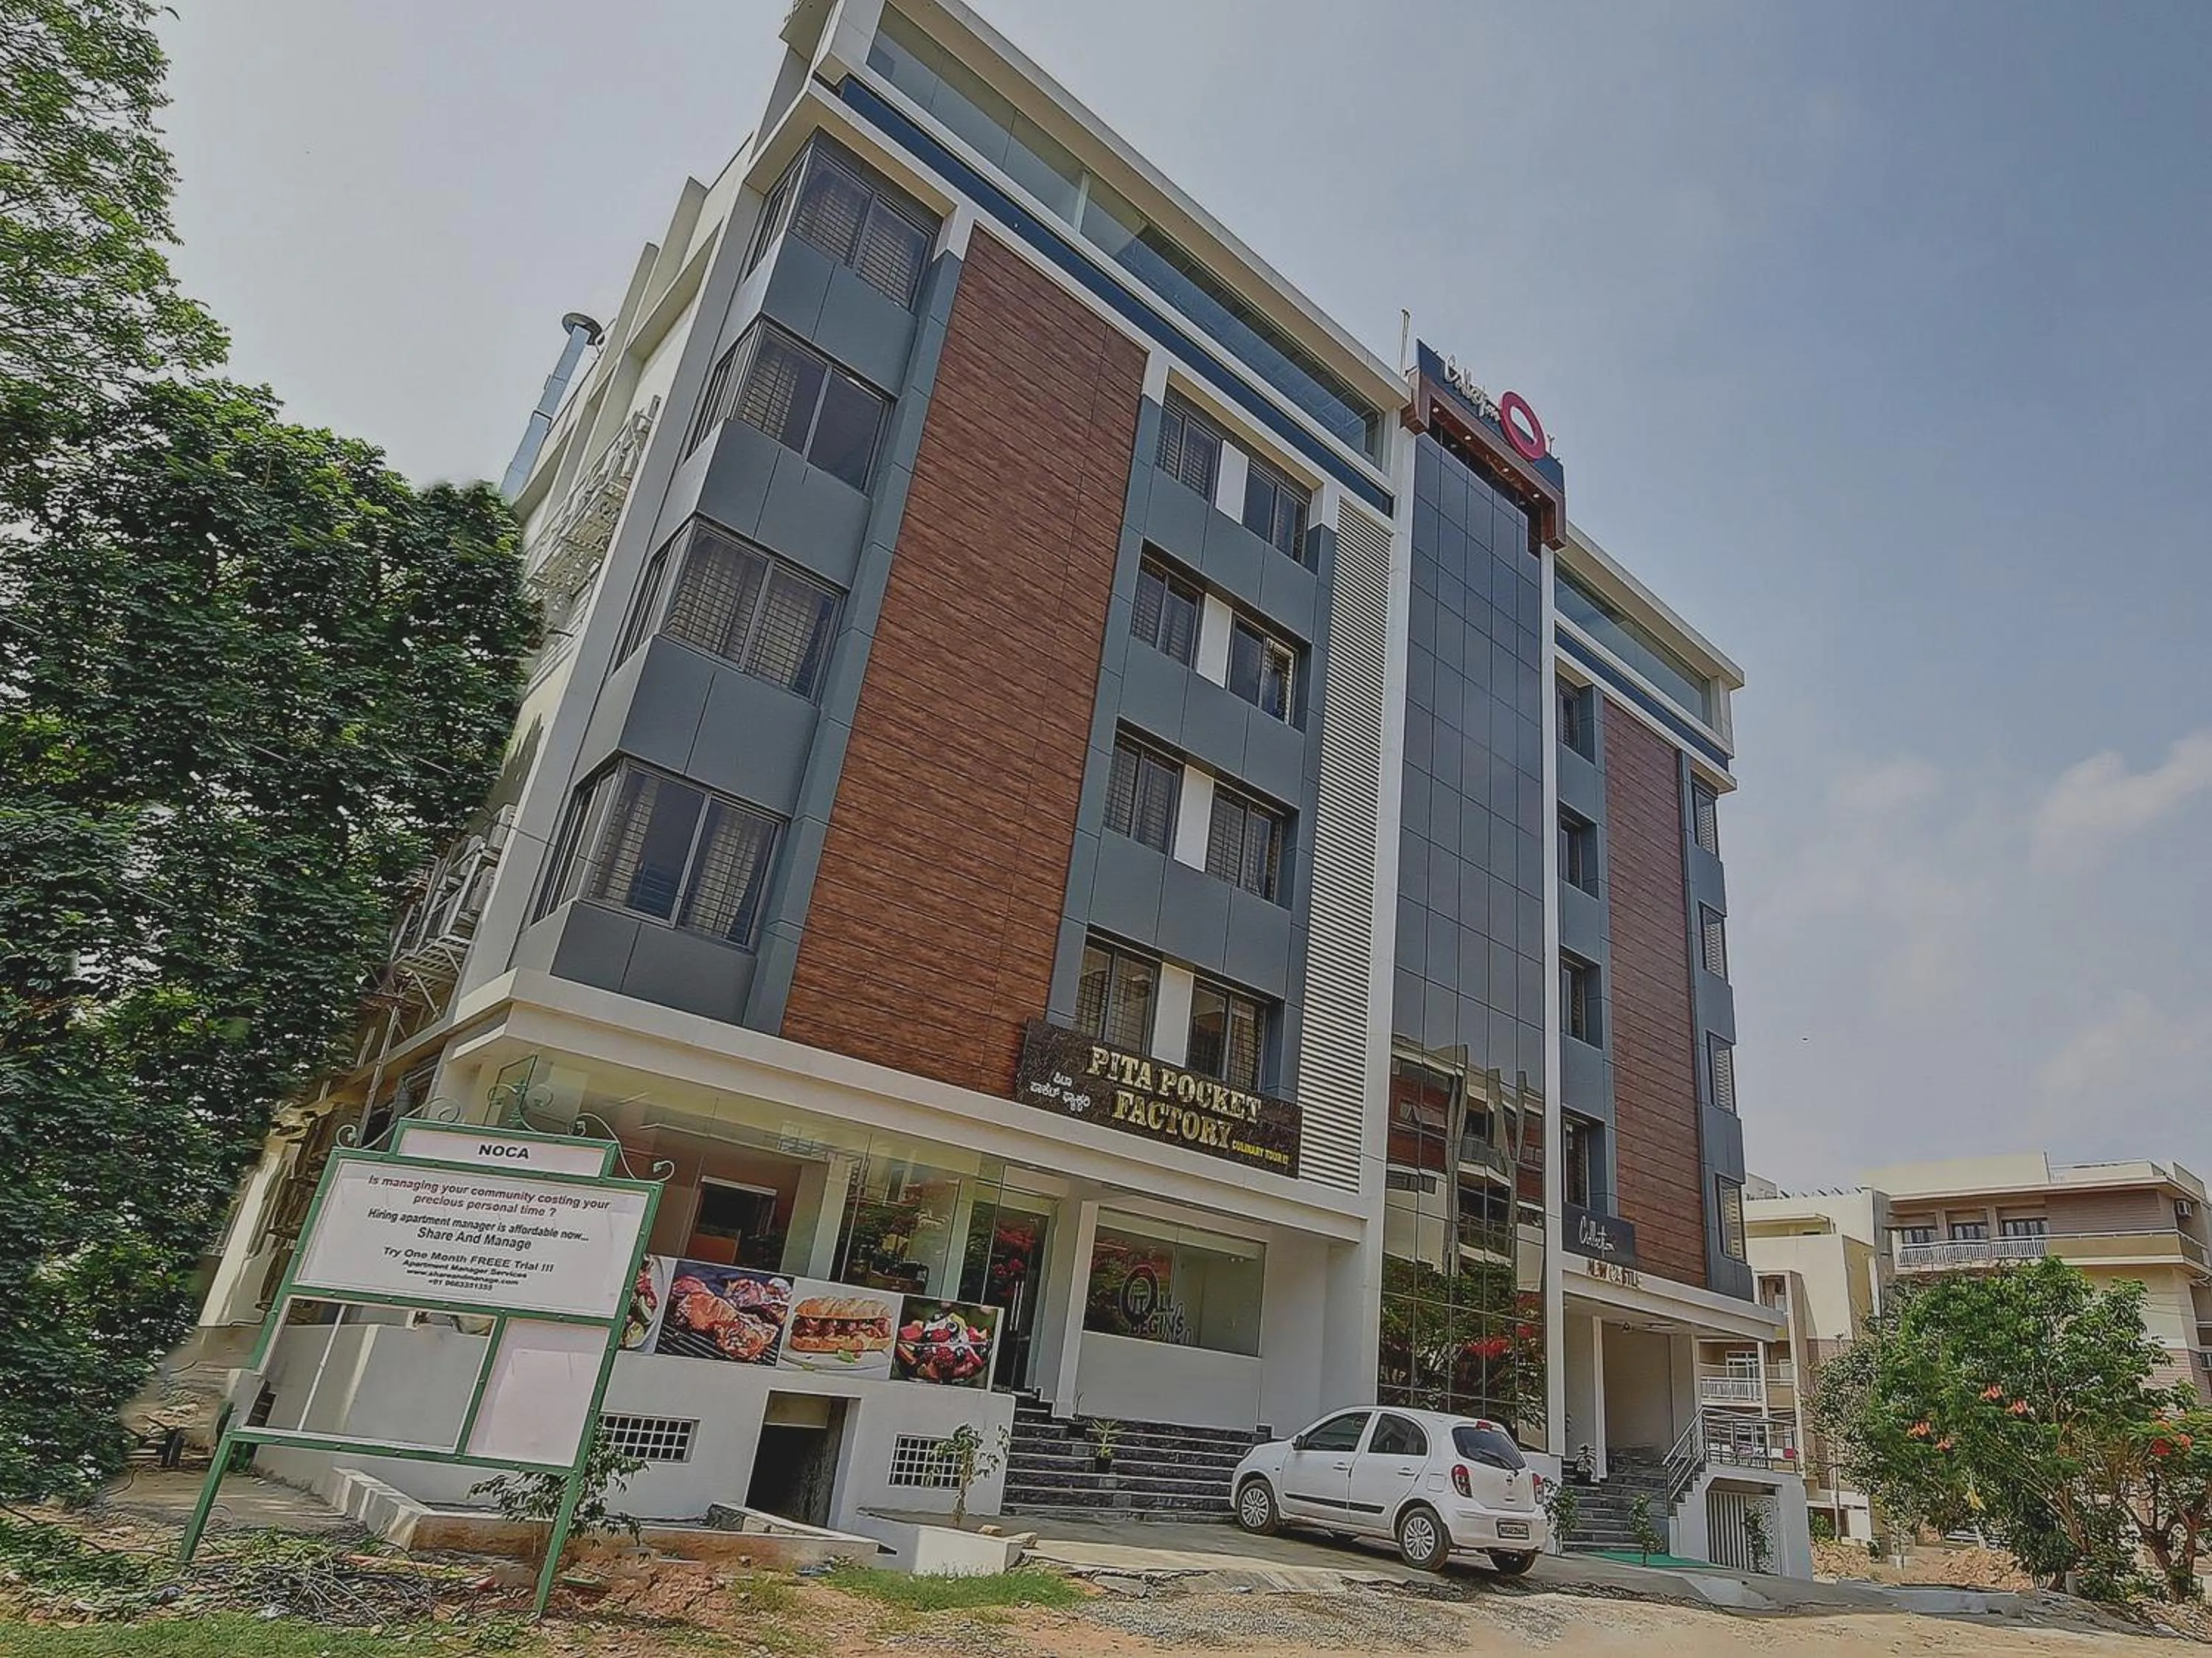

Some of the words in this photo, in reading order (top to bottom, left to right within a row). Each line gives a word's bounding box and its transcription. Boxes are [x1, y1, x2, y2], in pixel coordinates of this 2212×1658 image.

[1085, 1046, 1152, 1092] PITA
[1161, 1068, 1262, 1124] POCKET
[1113, 1090, 1234, 1148] FACTORY
[479, 1144, 530, 1160] NOCA
[369, 1175, 378, 1185] Is
[381, 1177, 439, 1193] managing
[441, 1184, 470, 1194] your
[470, 1186, 536, 1203] community
[538, 1194, 582, 1209] costing
[582, 1199, 611, 1210] your
[413, 1194, 464, 1207] precious
[466, 1200, 518, 1213] personal
[520, 1205, 546, 1216] time
[549, 1207, 557, 1217] ?
[368, 1207, 398, 1223] Hiring
[400, 1213, 450, 1227] apartment
[452, 1219, 496, 1232] manager
[497, 1222, 507, 1232] is
[508, 1224, 559, 1238] affordable
[417, 1227, 453, 1241] Share
[456, 1231, 481, 1244] And
[483, 1235, 532, 1251] Manage
[384, 1246, 402, 1258] Try
[404, 1249, 428, 1258] One
[431, 1252, 467, 1263] Month
[470, 1255, 512, 1268] FREEE
[515, 1260, 539, 1271] Trial
[402, 1259, 448, 1269] Apartment
[451, 1264, 488, 1274] Manager
